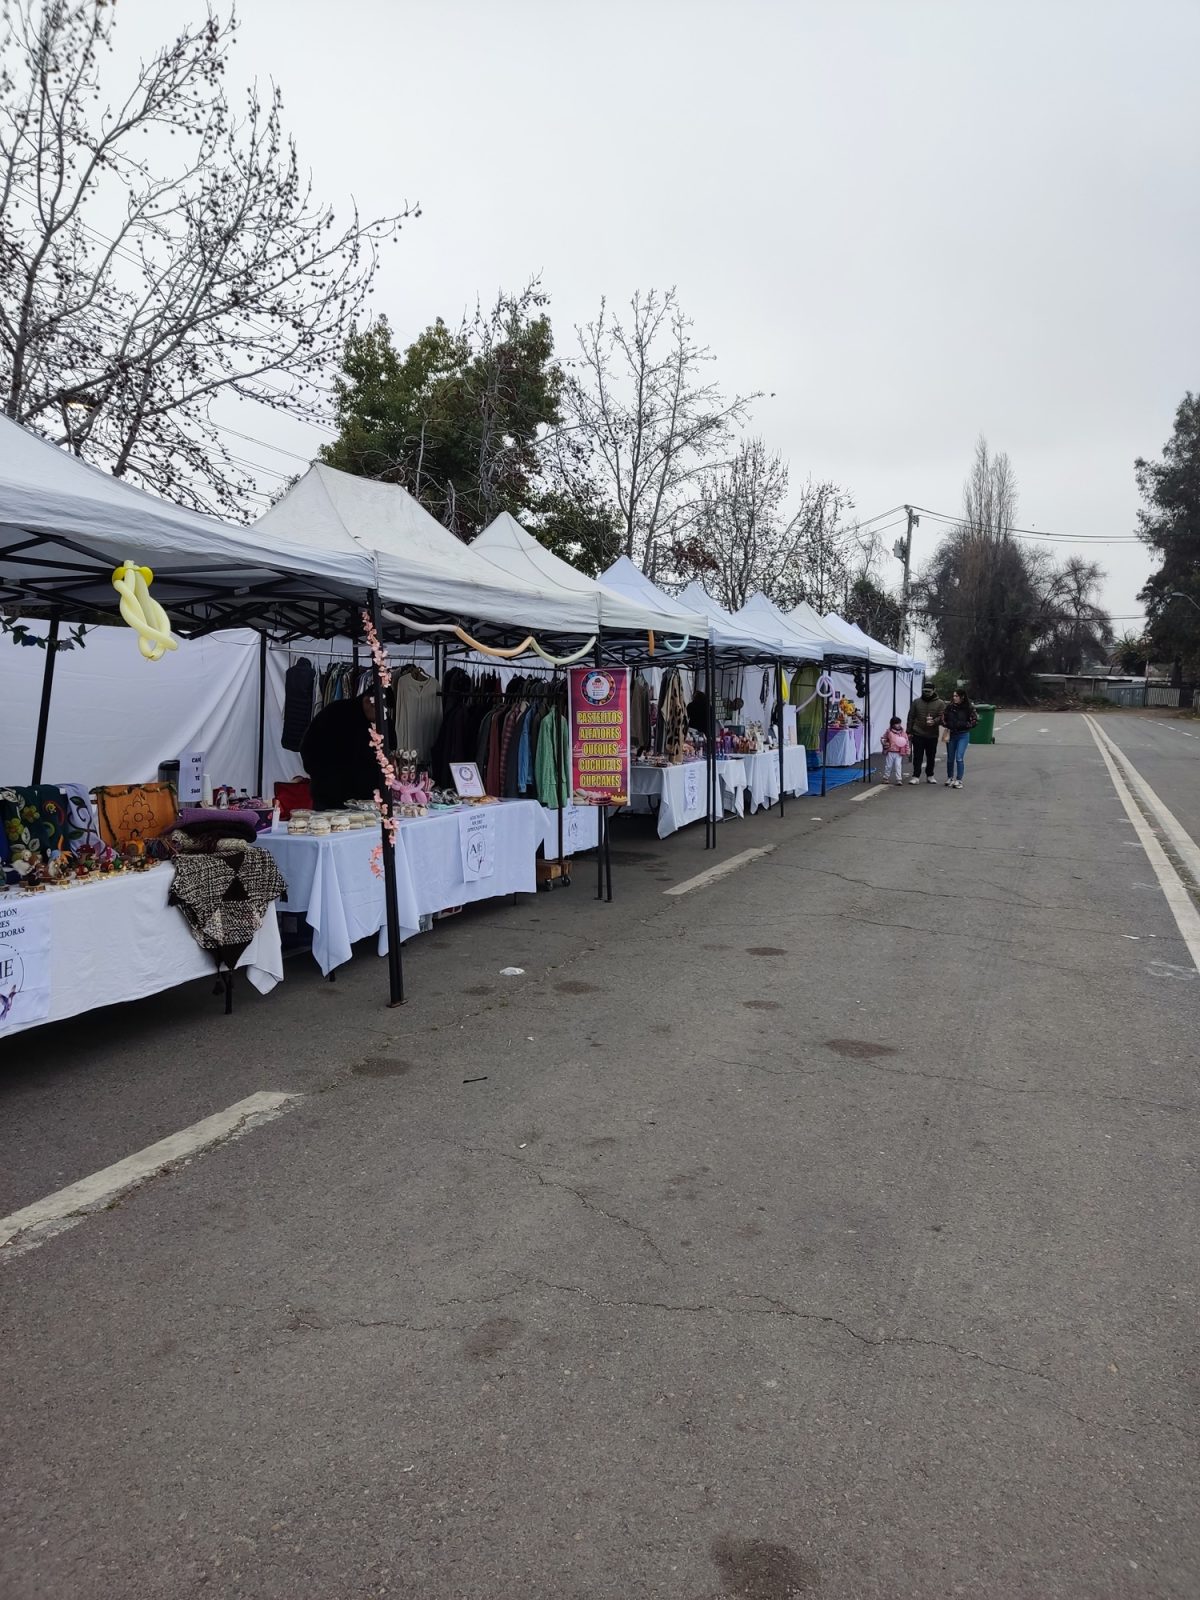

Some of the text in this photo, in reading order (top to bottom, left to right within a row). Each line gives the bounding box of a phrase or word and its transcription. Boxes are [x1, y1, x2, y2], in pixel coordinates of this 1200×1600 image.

[577, 711, 623, 724] PASTELITOS
[579, 727, 621, 740] ALFAJORES
[582, 743, 619, 756] QUEQUES
[580, 774, 621, 787] CUPCAKES
